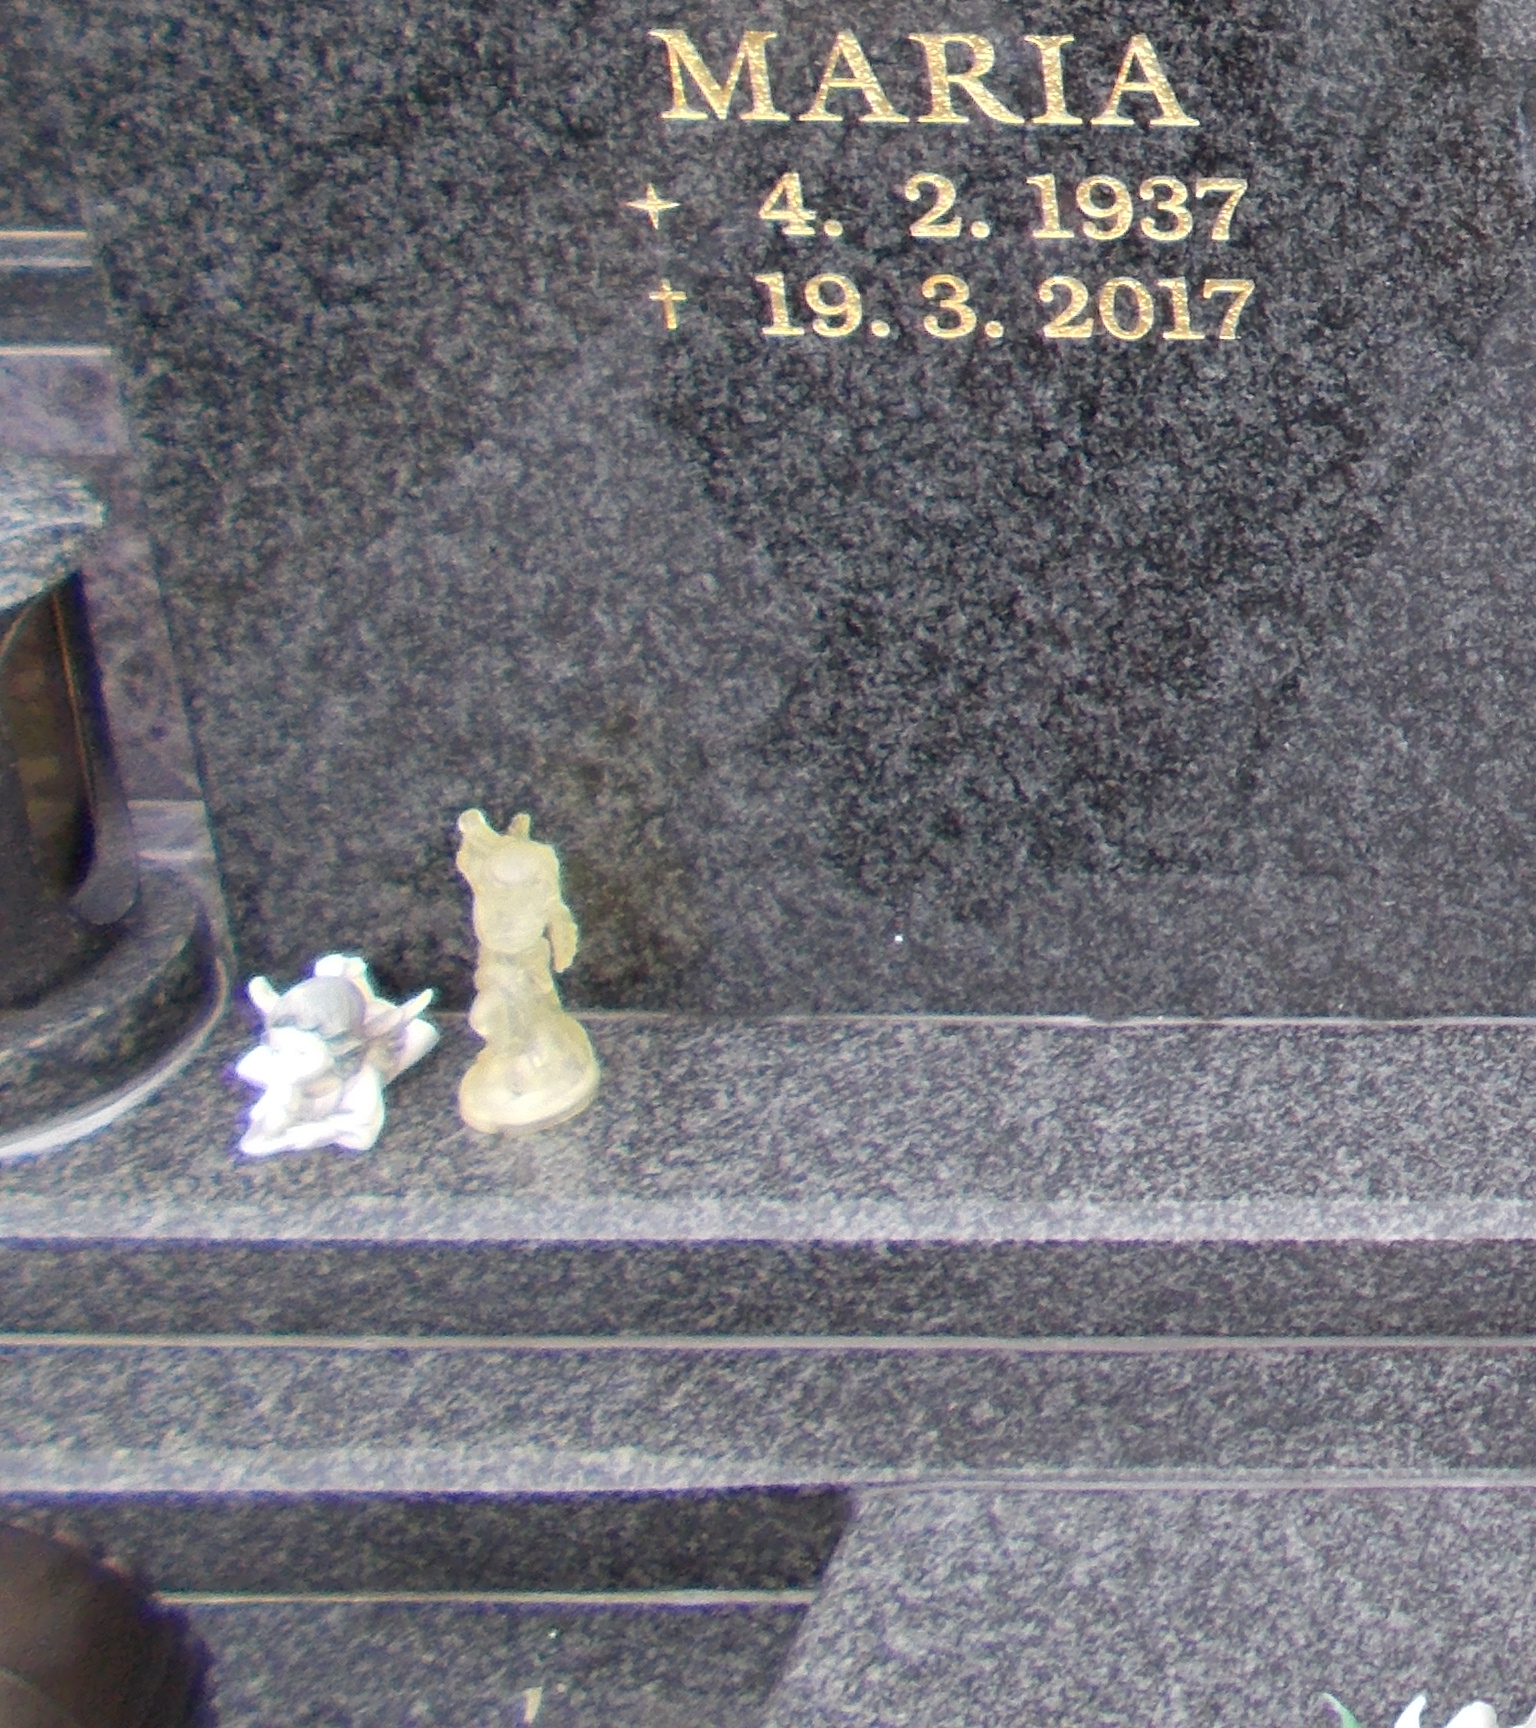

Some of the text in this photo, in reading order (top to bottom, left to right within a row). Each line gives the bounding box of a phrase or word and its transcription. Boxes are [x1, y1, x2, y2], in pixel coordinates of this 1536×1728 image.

[648, 28, 1201, 127] MARIA
[757, 171, 1249, 241] 4. 2. 1937
[754, 271, 1256, 341] 19. 3. 2017
